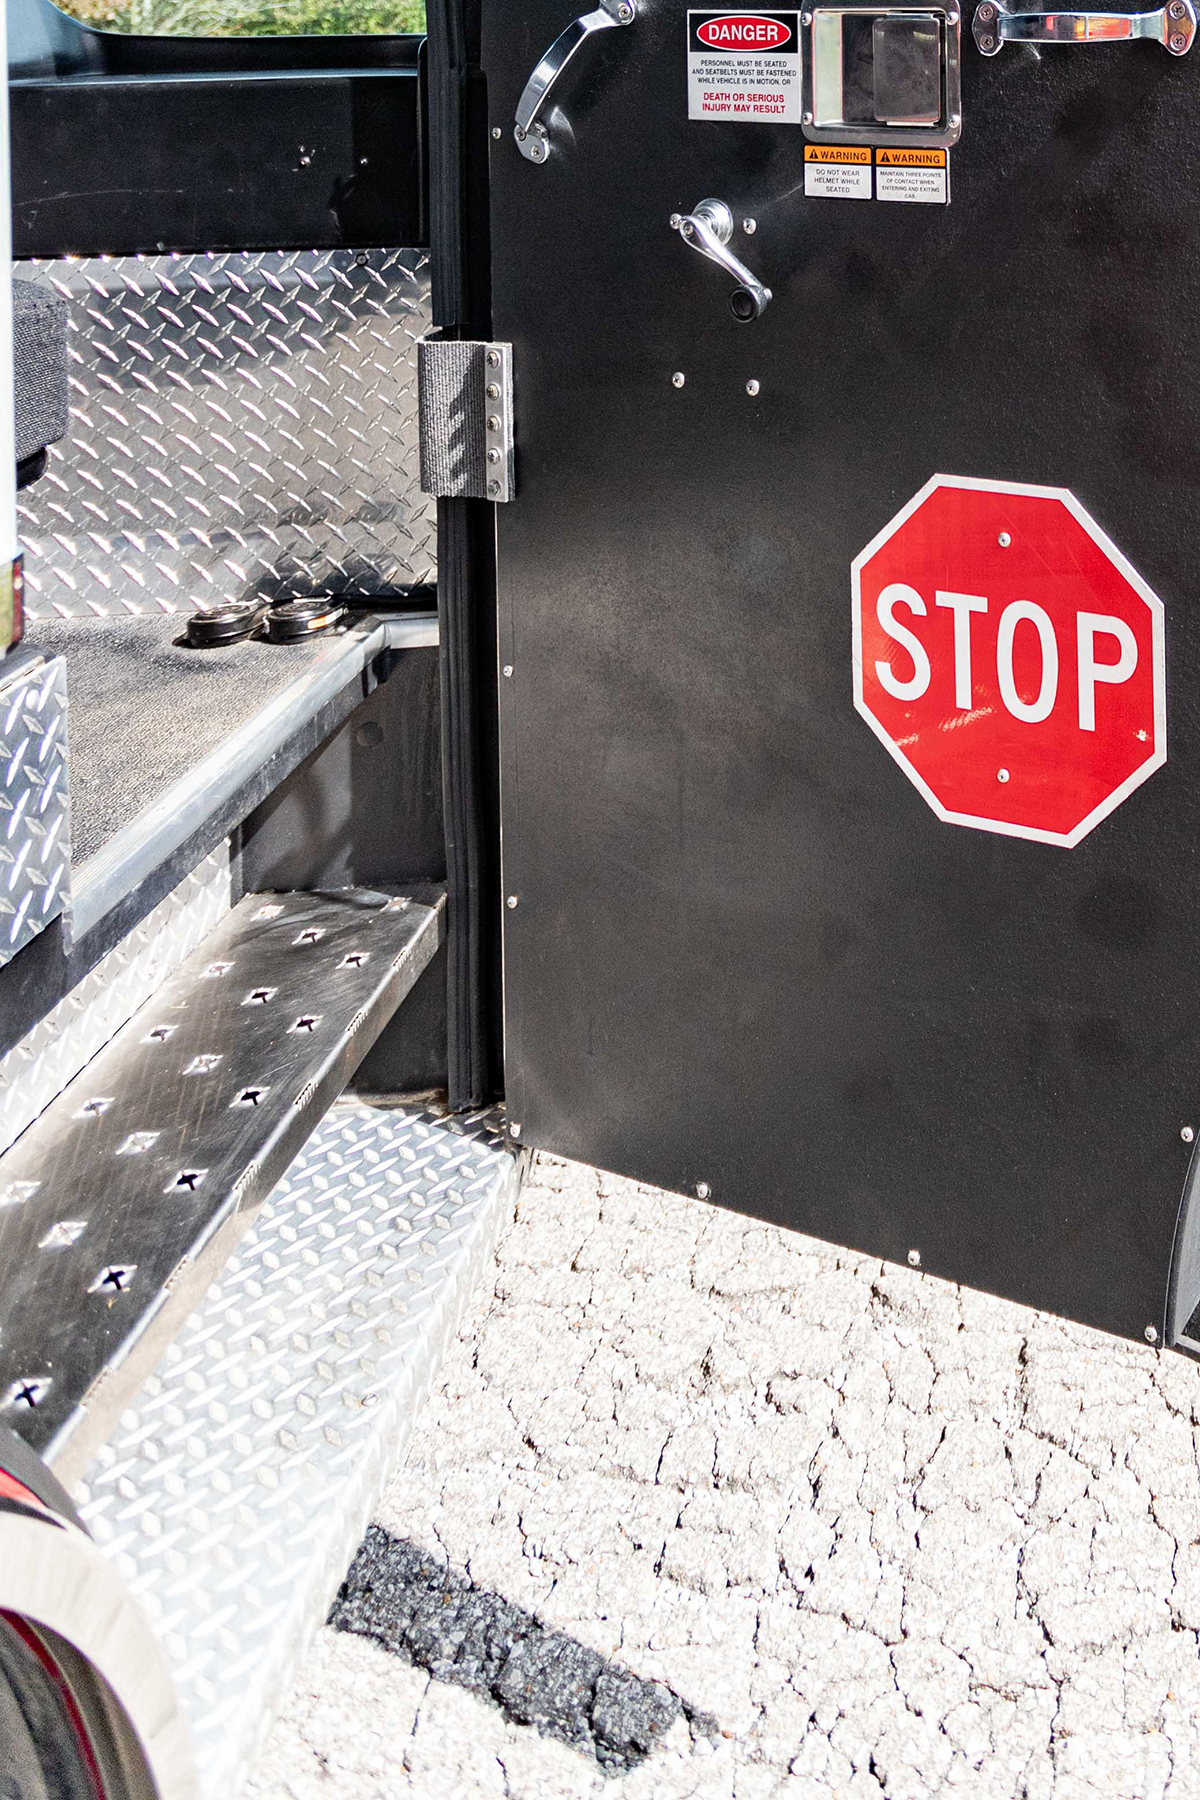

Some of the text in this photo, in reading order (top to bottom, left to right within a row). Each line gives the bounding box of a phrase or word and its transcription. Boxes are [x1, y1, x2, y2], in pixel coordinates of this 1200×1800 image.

[708, 24, 778, 41] DANGER
[701, 59, 787, 68] PERSONNEL MUST BE SEATED
[705, 68, 738, 76] SEATBELTS
[756, 69, 765, 77] BE
[697, 77, 715, 85] WHILE
[782, 78, 791, 86] OR
[703, 92, 785, 103] DEATH OR SERIOUS
[702, 103, 786, 114] INJURY MAY RESULT
[820, 150, 867, 161] WARNING
[891, 153, 940, 164] WARNING
[840, 178, 860, 186] WHILE
[825, 185, 851, 193] SEATED
[874, 582, 1139, 732] STOP
